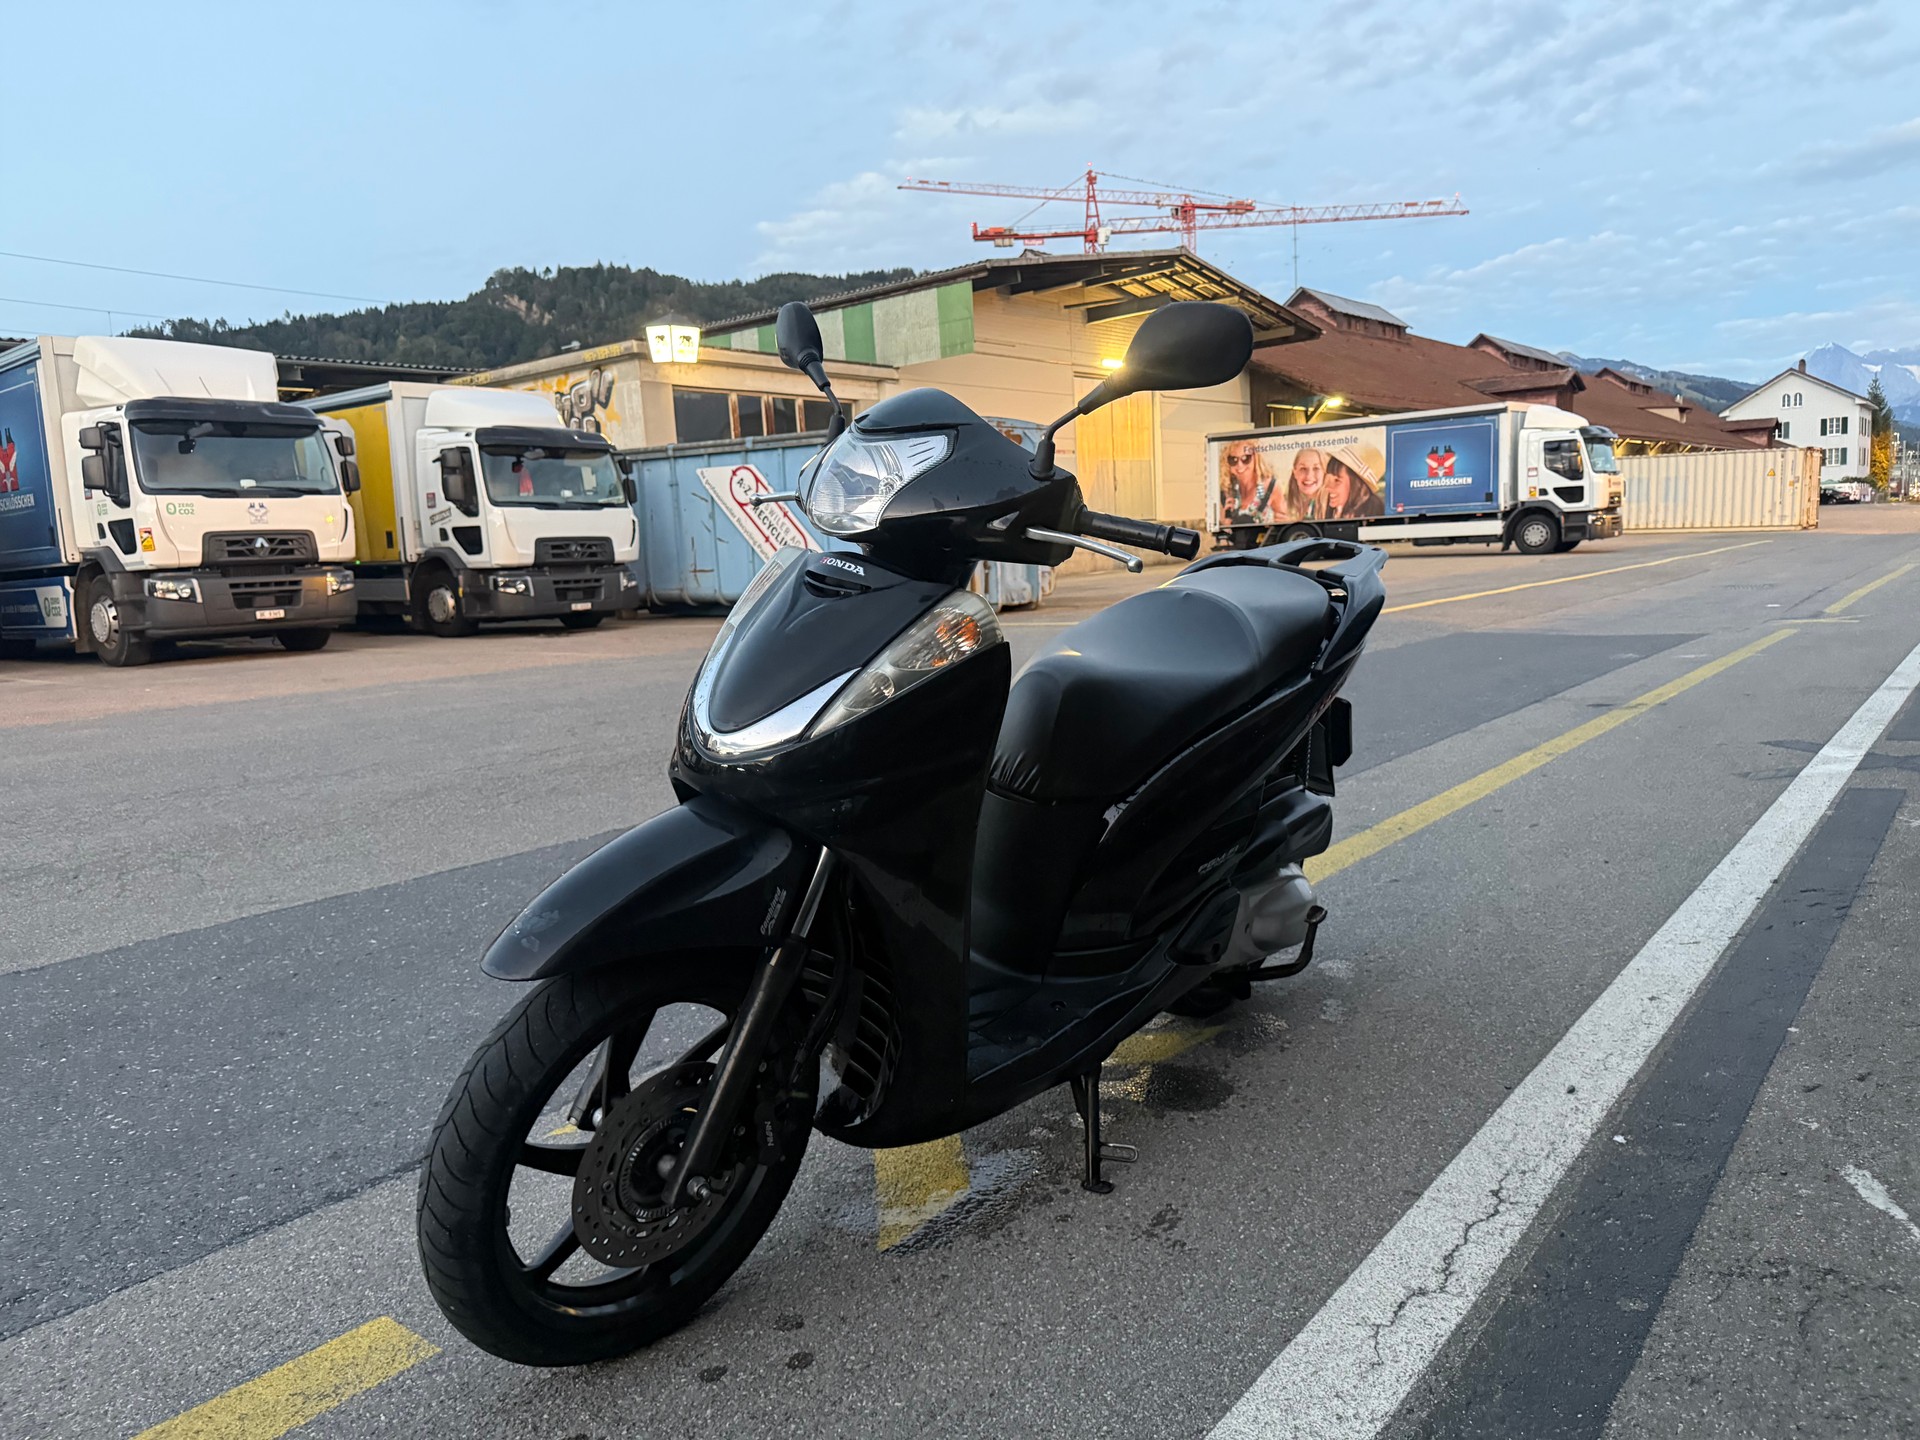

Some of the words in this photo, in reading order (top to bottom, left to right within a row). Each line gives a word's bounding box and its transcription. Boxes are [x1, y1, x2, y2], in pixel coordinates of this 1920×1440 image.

[1313, 435, 1359, 448] rassemble
[1409, 476, 1473, 488] FELDSCHLÖSSCHEN
[820, 556, 865, 577] HONDA
